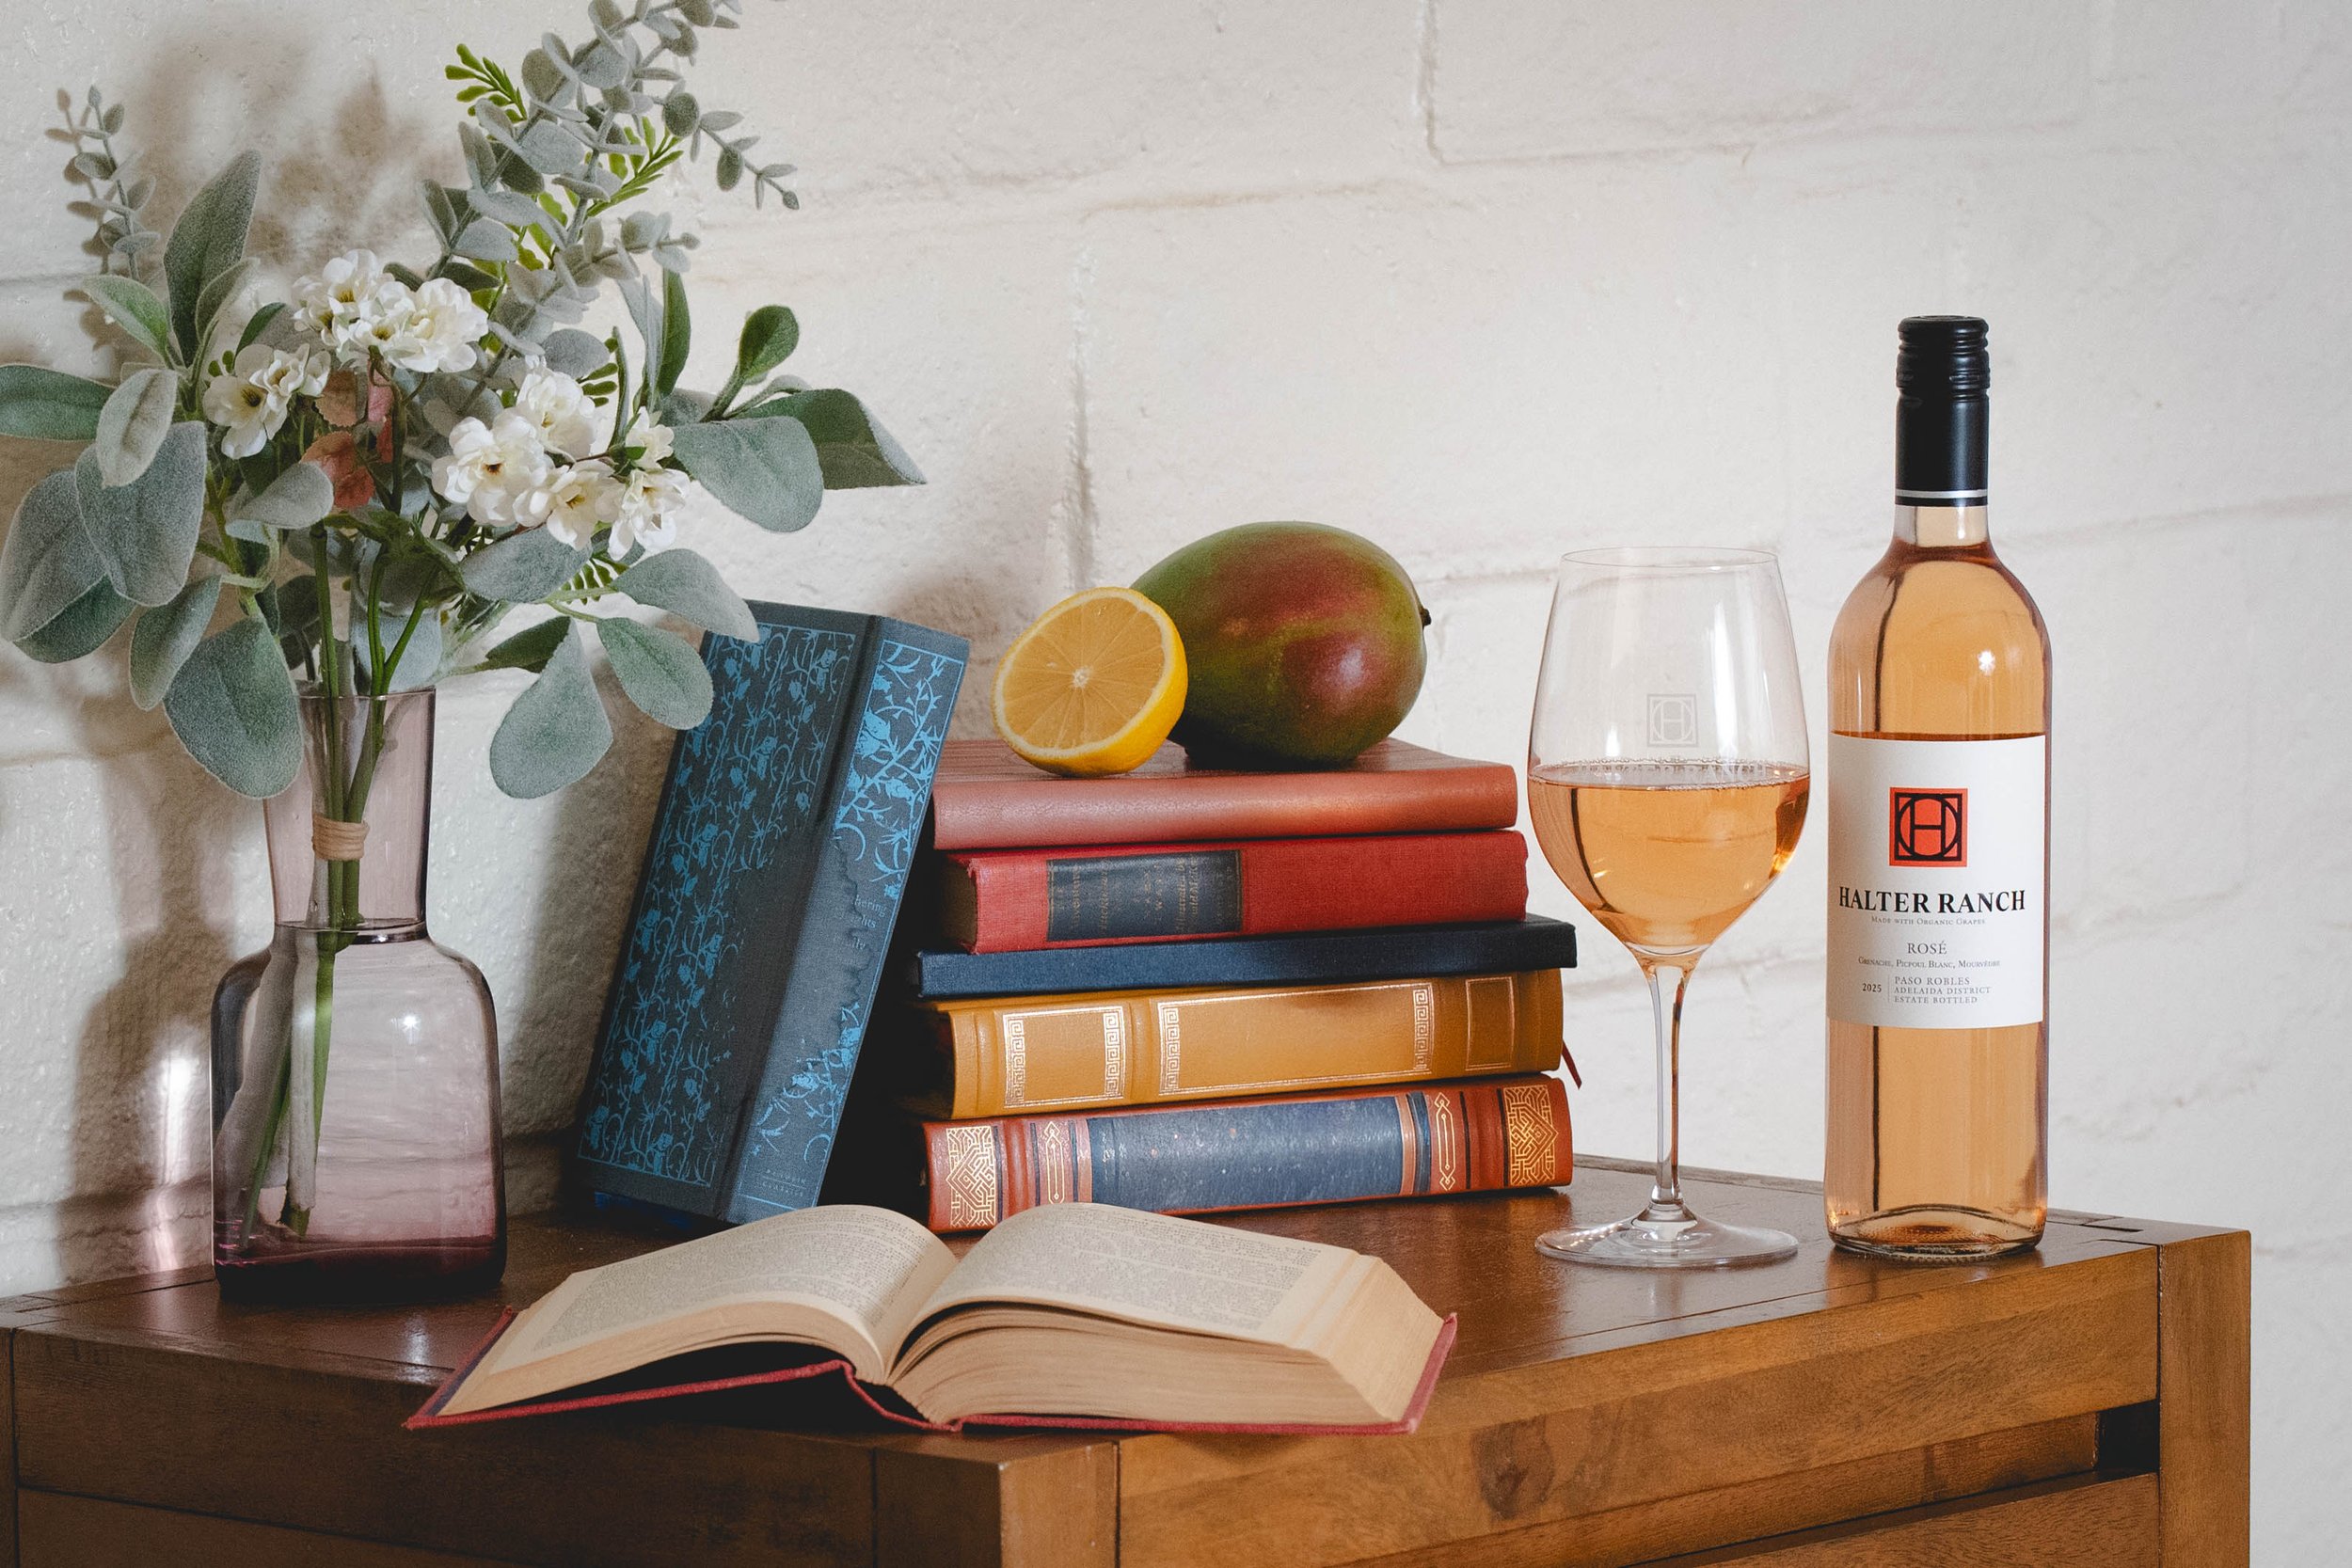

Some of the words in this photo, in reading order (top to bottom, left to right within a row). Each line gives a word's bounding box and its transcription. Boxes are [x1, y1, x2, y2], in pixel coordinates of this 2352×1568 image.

[1839, 886, 1931, 913] HALTER
[1938, 889, 2026, 913] RANCH
[1907, 940, 1947, 955] ROSÉ
[1894, 975, 1922, 986] PASO
[1926, 976, 1971, 986] ROBLES
[1862, 982, 1883, 993] 2025
[1894, 987, 1943, 995] ADELAIDA
[1947, 987, 1992, 995] DISTRICT
[1894, 995, 1929, 1004] ESTATE
[1932, 996, 1979, 1005] BOTTLED
